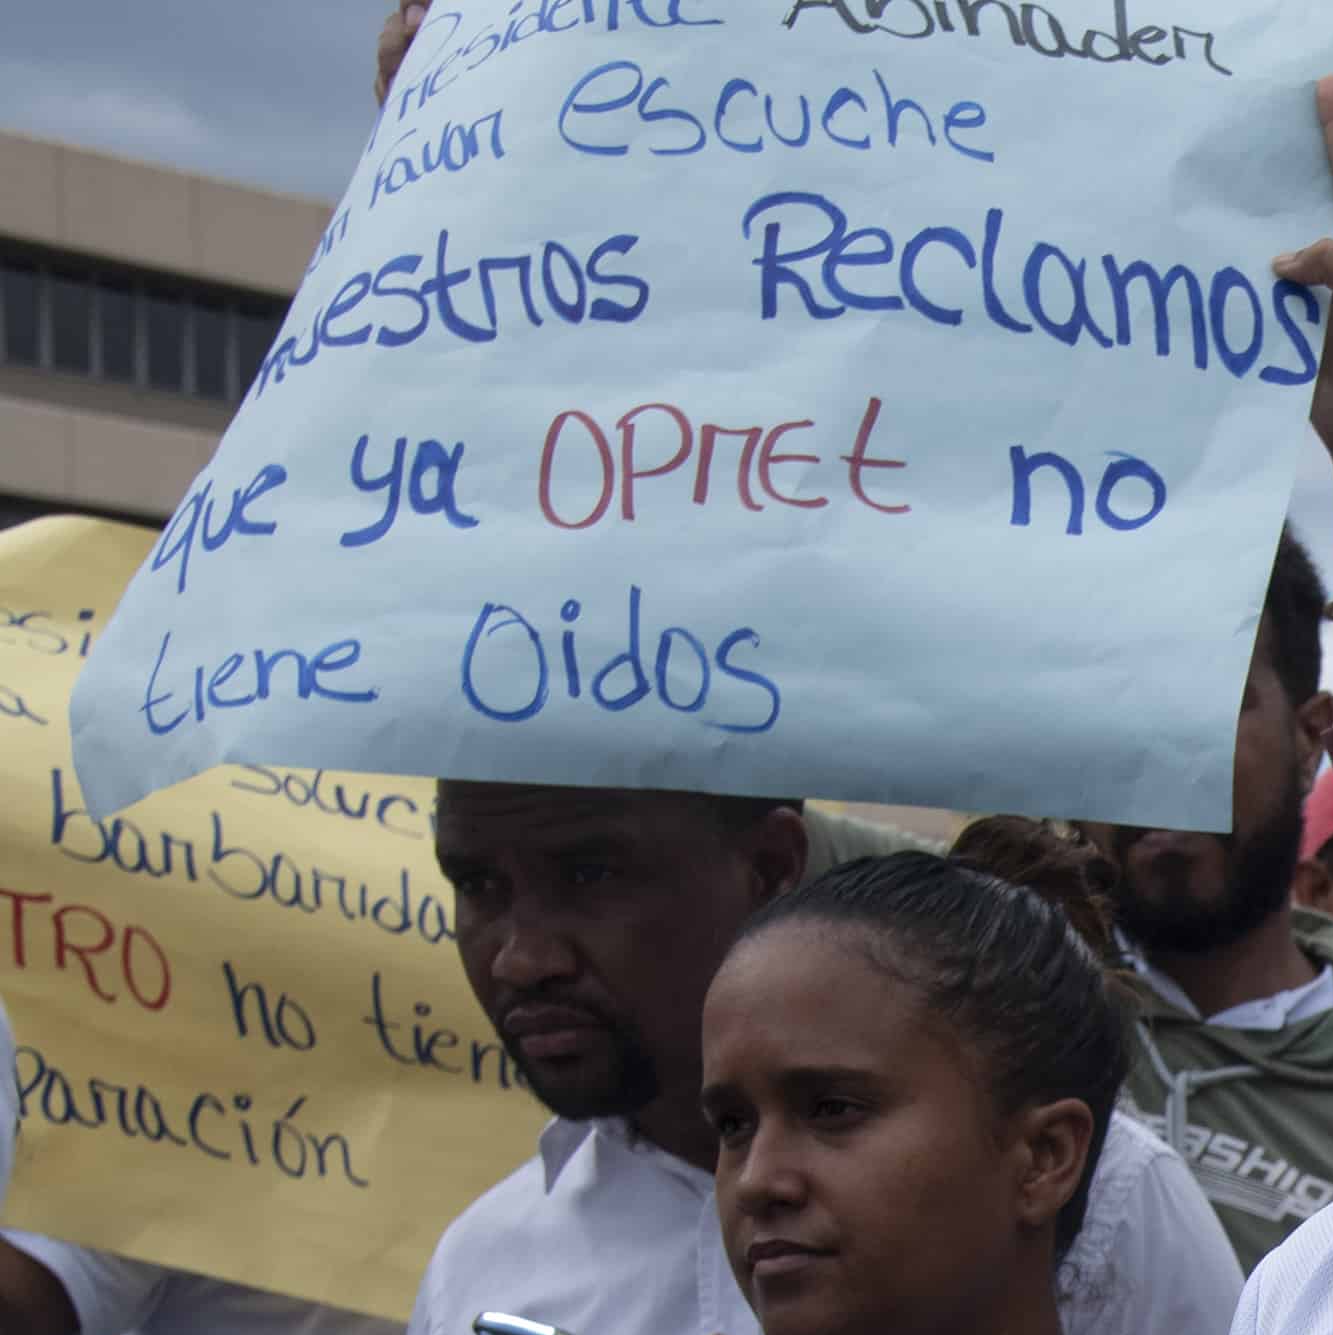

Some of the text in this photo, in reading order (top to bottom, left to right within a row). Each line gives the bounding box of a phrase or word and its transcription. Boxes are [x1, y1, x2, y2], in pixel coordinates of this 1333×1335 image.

[367, 108, 505, 209] favor
[558, 60, 995, 162] escuche
[742, 191, 1320, 386] Reclamos
[151, 464, 287, 593] que
[339, 434, 480, 547] ya
[1010, 442, 1167, 535] no
[138, 585, 781, 736] tiene Oidos
[51, 767, 457, 944] barbarida
[0, 888, 172, 1012] TRO
[222, 960, 317, 1051] no
